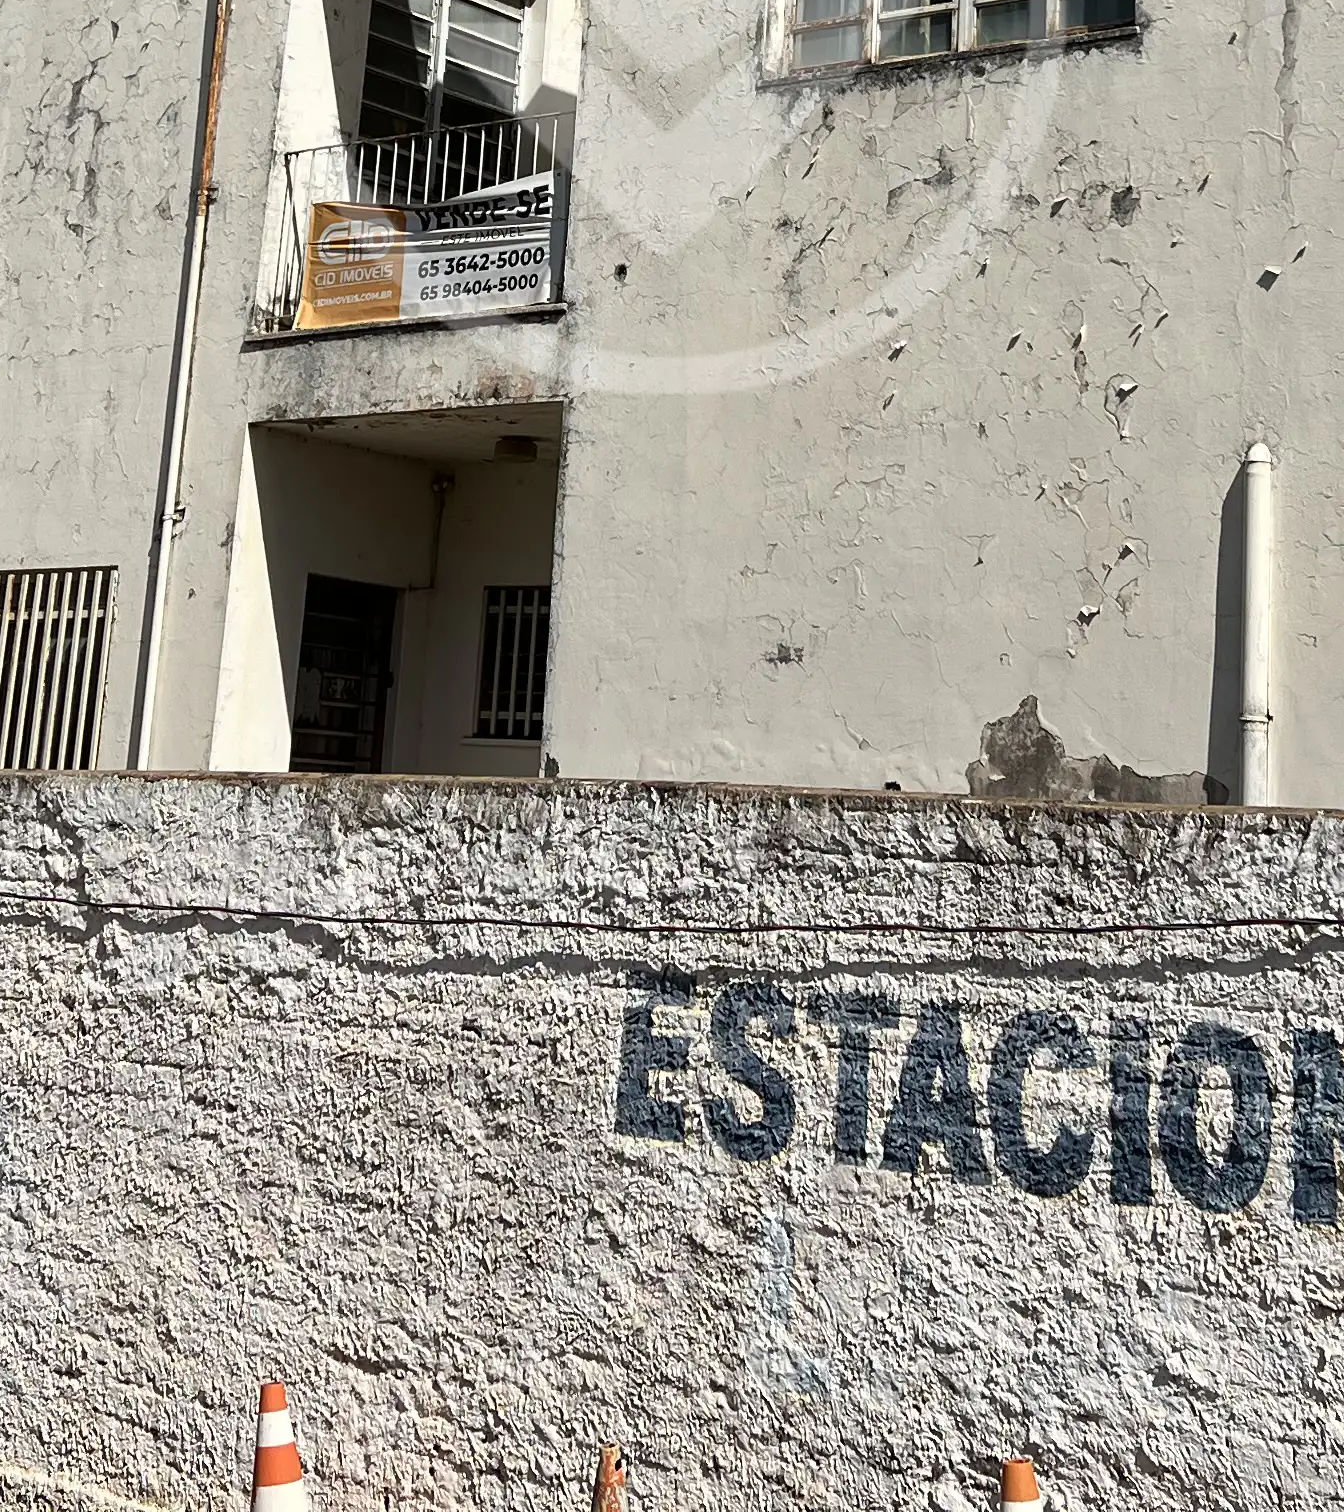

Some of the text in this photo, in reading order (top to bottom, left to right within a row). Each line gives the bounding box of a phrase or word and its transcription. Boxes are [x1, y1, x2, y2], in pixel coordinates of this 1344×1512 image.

[415, 184, 551, 231] VENDE-SE
[318, 218, 396, 265] CID
[440, 232, 472, 245] ESTE
[314, 263, 394, 286] CID IMOVEIS
[418, 246, 545, 278] 65 3642-5000
[420, 273, 538, 301] 65 98404-5000
